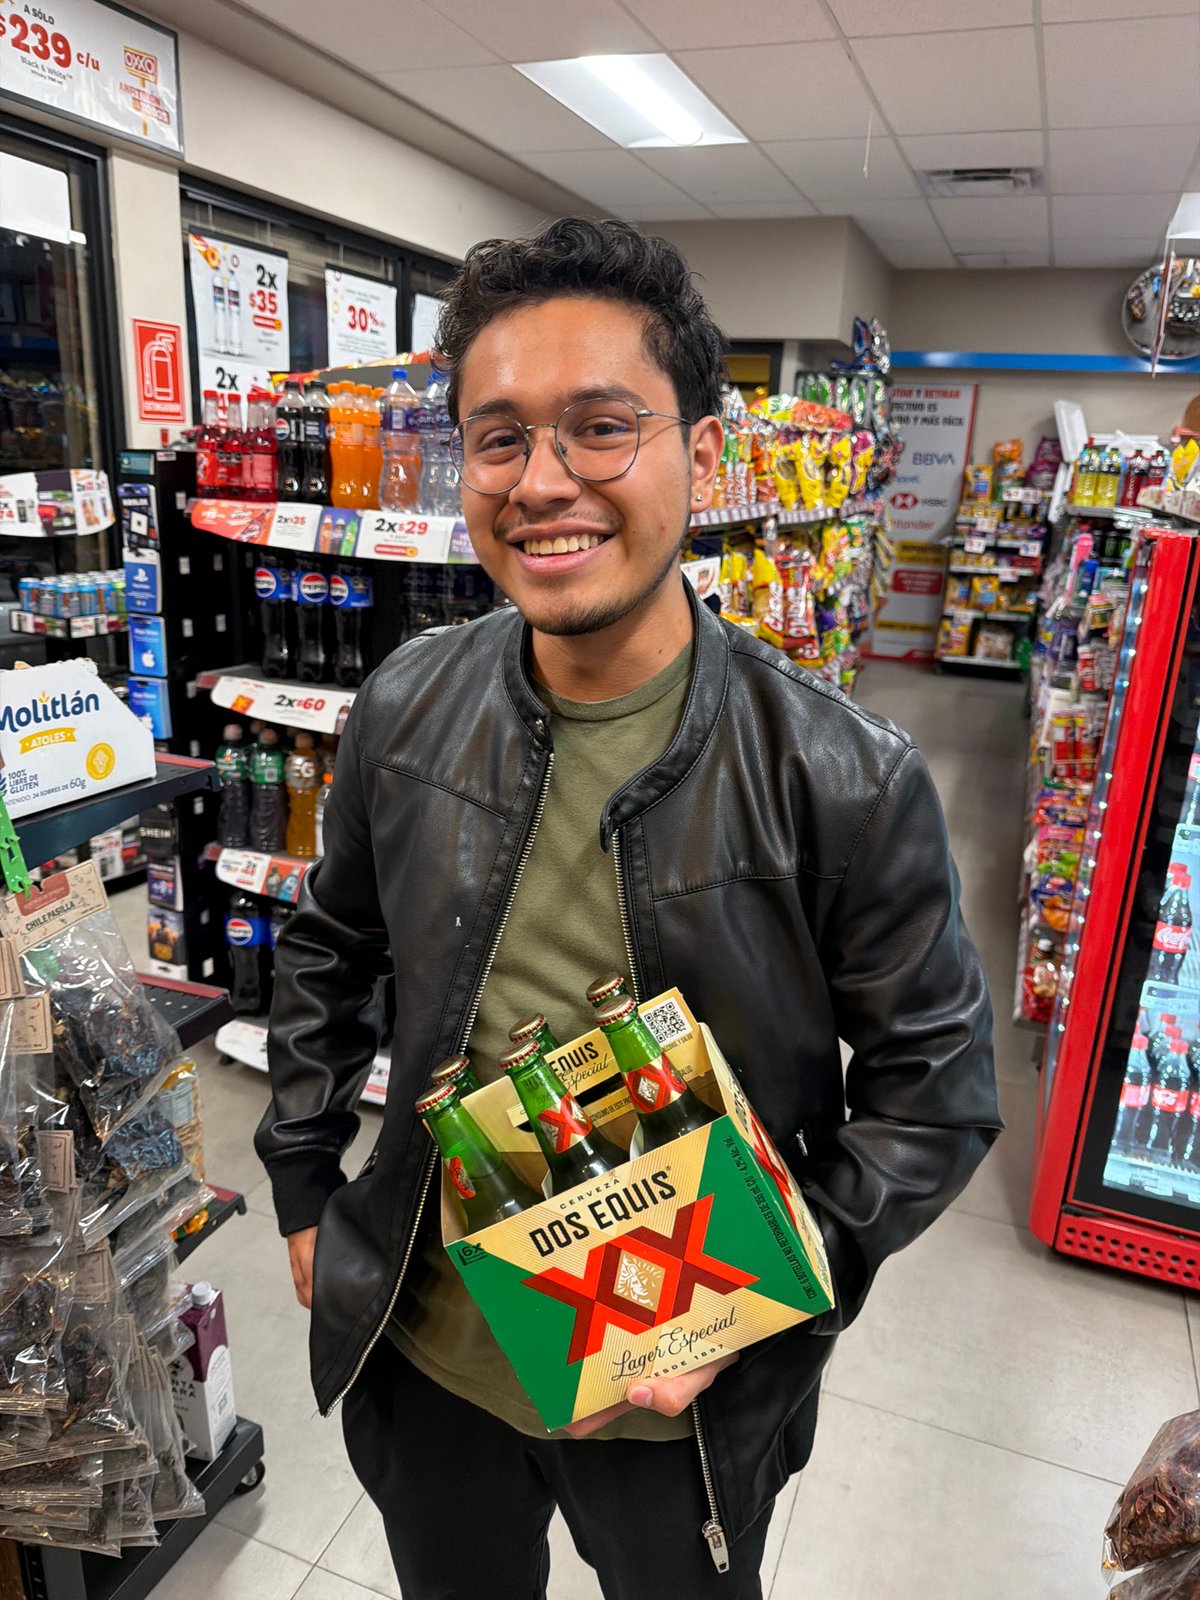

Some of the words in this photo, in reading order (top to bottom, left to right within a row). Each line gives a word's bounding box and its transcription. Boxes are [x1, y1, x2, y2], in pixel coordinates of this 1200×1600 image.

[24, 4, 31, 15] A
[76, 52, 100, 71] c/u
[256, 264, 278, 290] 2x
[249, 290, 278, 314] $35
[215, 366, 239, 391] 2x
[912, 451, 956, 466] BBVA
[30, 731, 66, 748] ATOLES
[8, 769, 27, 780] 100%
[9, 777, 28, 787] LIBRE
[29, 773, 39, 782] DE
[10, 781, 39, 795] GLUTEN
[40, 786, 61, 797] SOBRES
[139, 827, 171, 838] SHEIN
[25, 915, 48, 931] CHILE
[47, 901, 76, 920] PASILLA
[559, 1178, 621, 1210] CERVEZA
[528, 1211, 590, 1257] DOS
[612, 1346, 665, 1381] Lager
[659, 1306, 737, 1355] Especial
[693, 1344, 725, 1361] 1897
